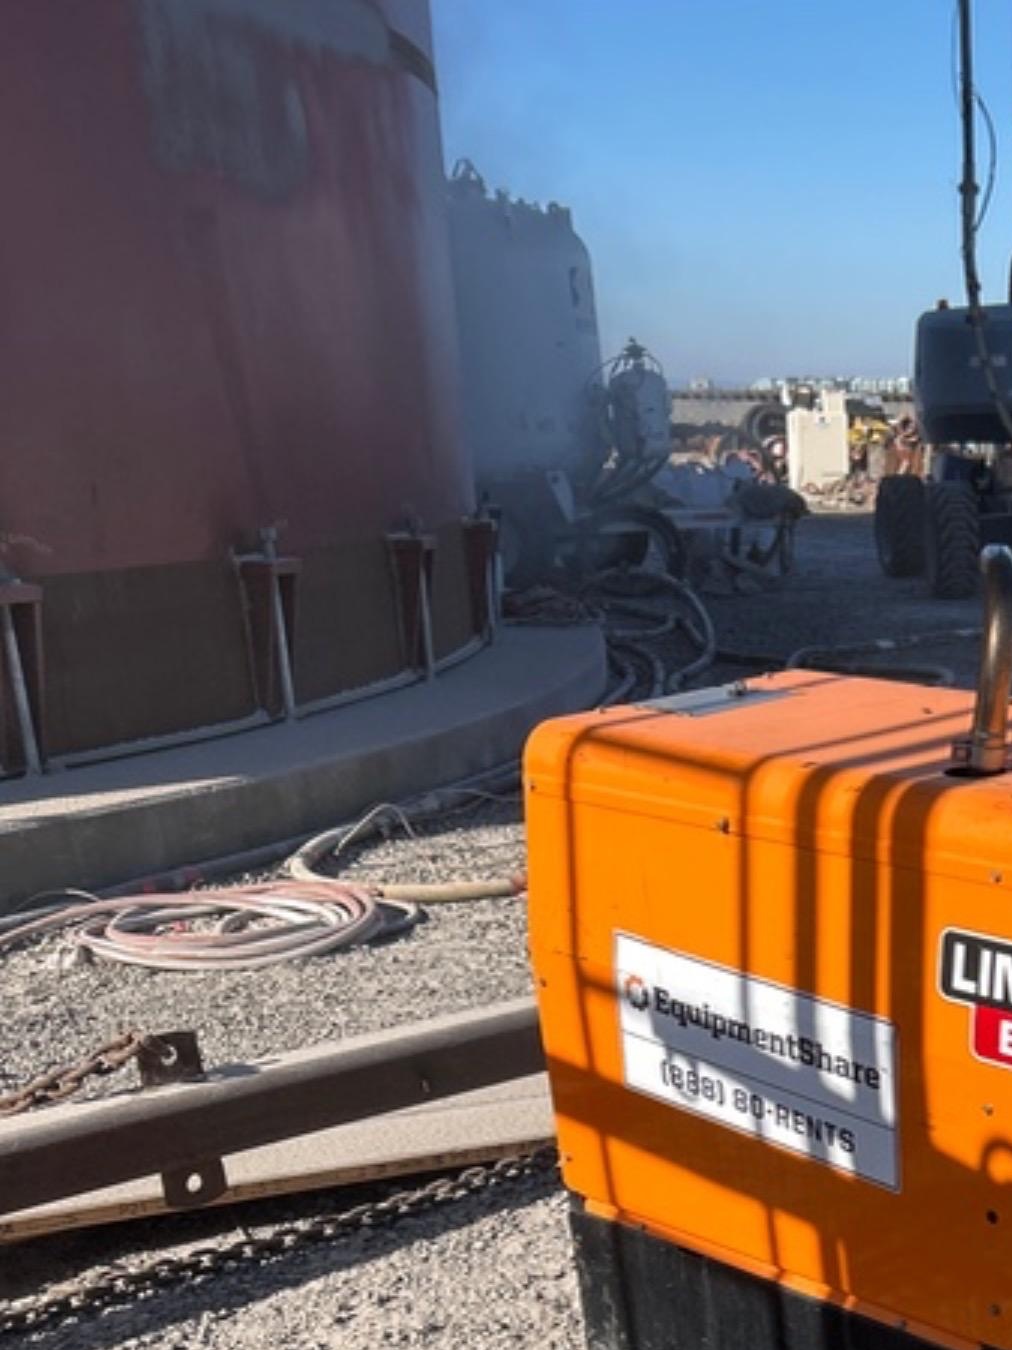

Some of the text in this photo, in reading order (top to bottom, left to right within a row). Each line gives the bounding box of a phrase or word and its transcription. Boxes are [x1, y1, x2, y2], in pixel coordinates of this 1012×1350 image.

[653, 986, 881, 1090] EquipmentShare
[660, 1057, 857, 1153] (888) 80-RENTS
